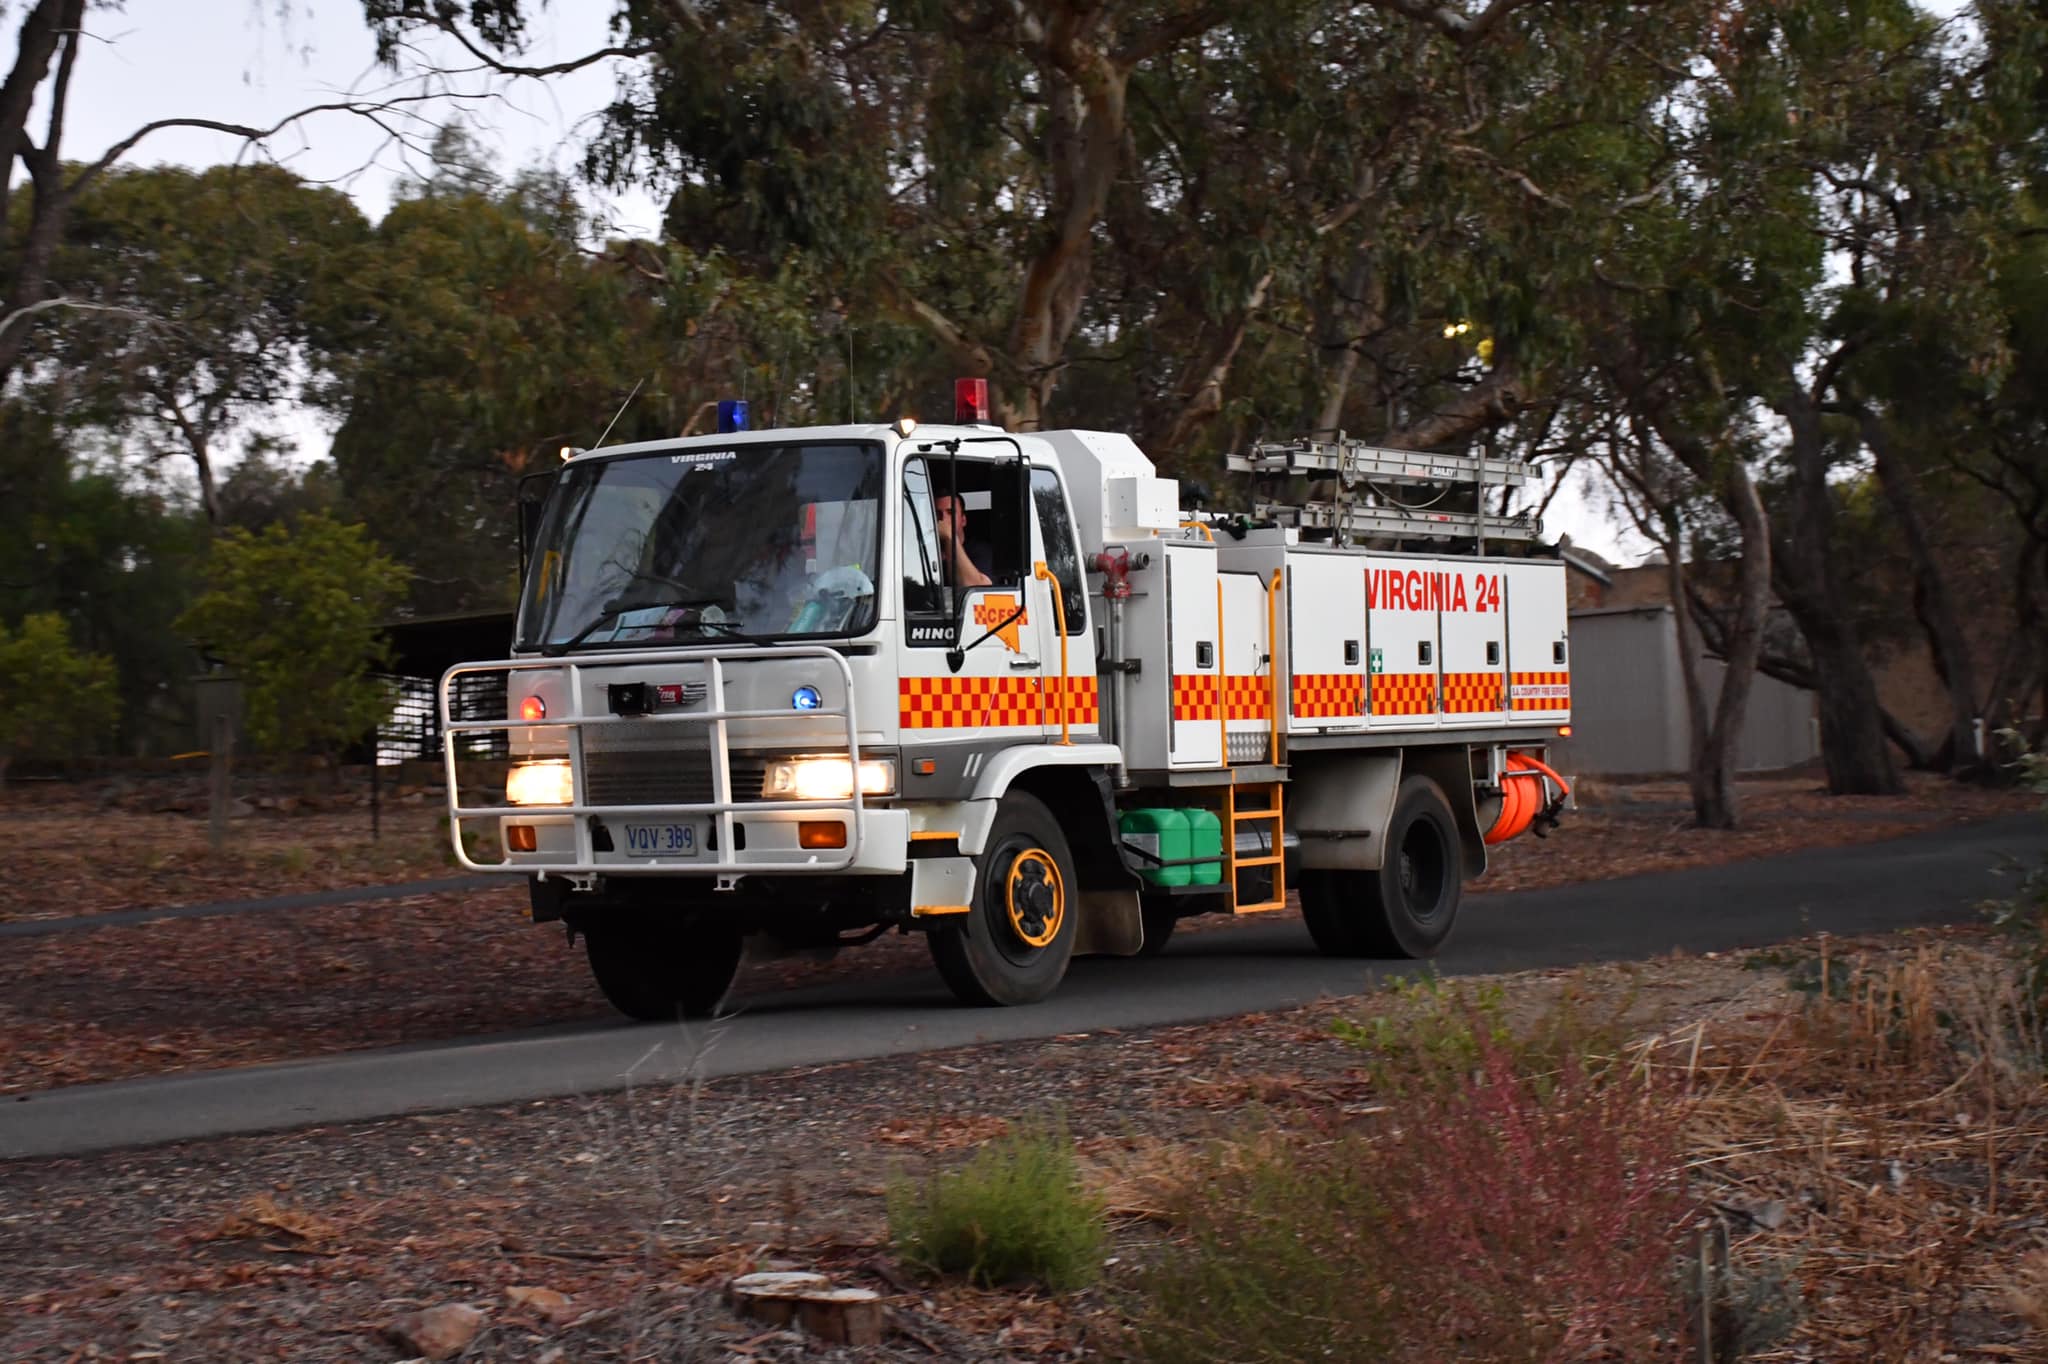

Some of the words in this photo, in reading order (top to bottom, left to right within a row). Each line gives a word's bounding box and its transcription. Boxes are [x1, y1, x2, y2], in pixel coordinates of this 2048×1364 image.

[671, 451, 737, 464] VIRGINIA
[694, 462, 714, 472] 24
[1364, 568, 1468, 612] VIRGINIA
[1475, 573, 1500, 613] 24
